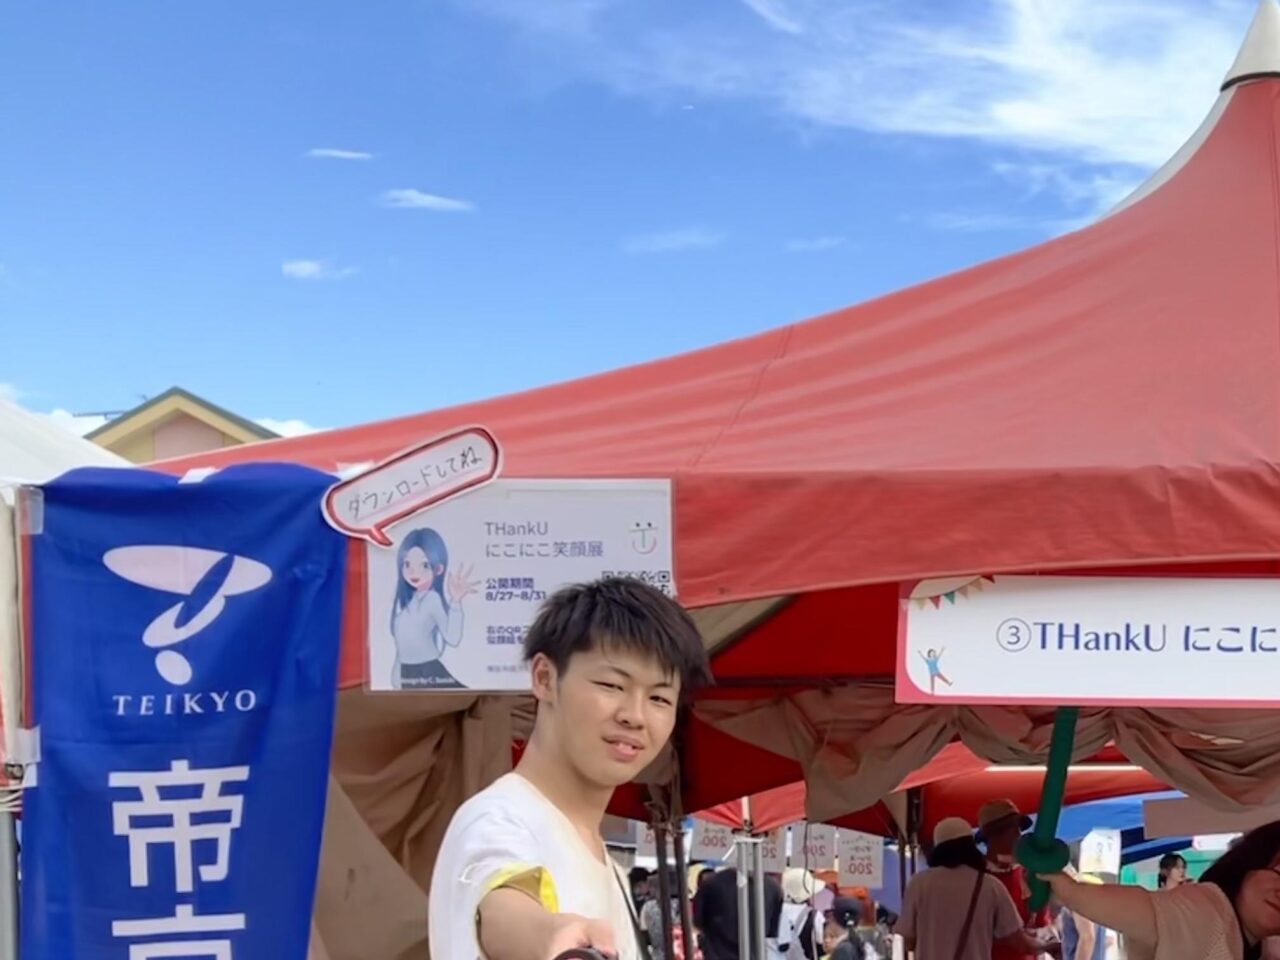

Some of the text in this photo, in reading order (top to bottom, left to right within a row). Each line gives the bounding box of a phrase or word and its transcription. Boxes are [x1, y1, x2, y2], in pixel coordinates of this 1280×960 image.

[349, 446, 483, 519] ダウンロードしてね
[485, 522, 548, 536] THankU
[485, 541, 604, 558] にこにこ笑顔展
[112, 689, 256, 716] TEIKYO
